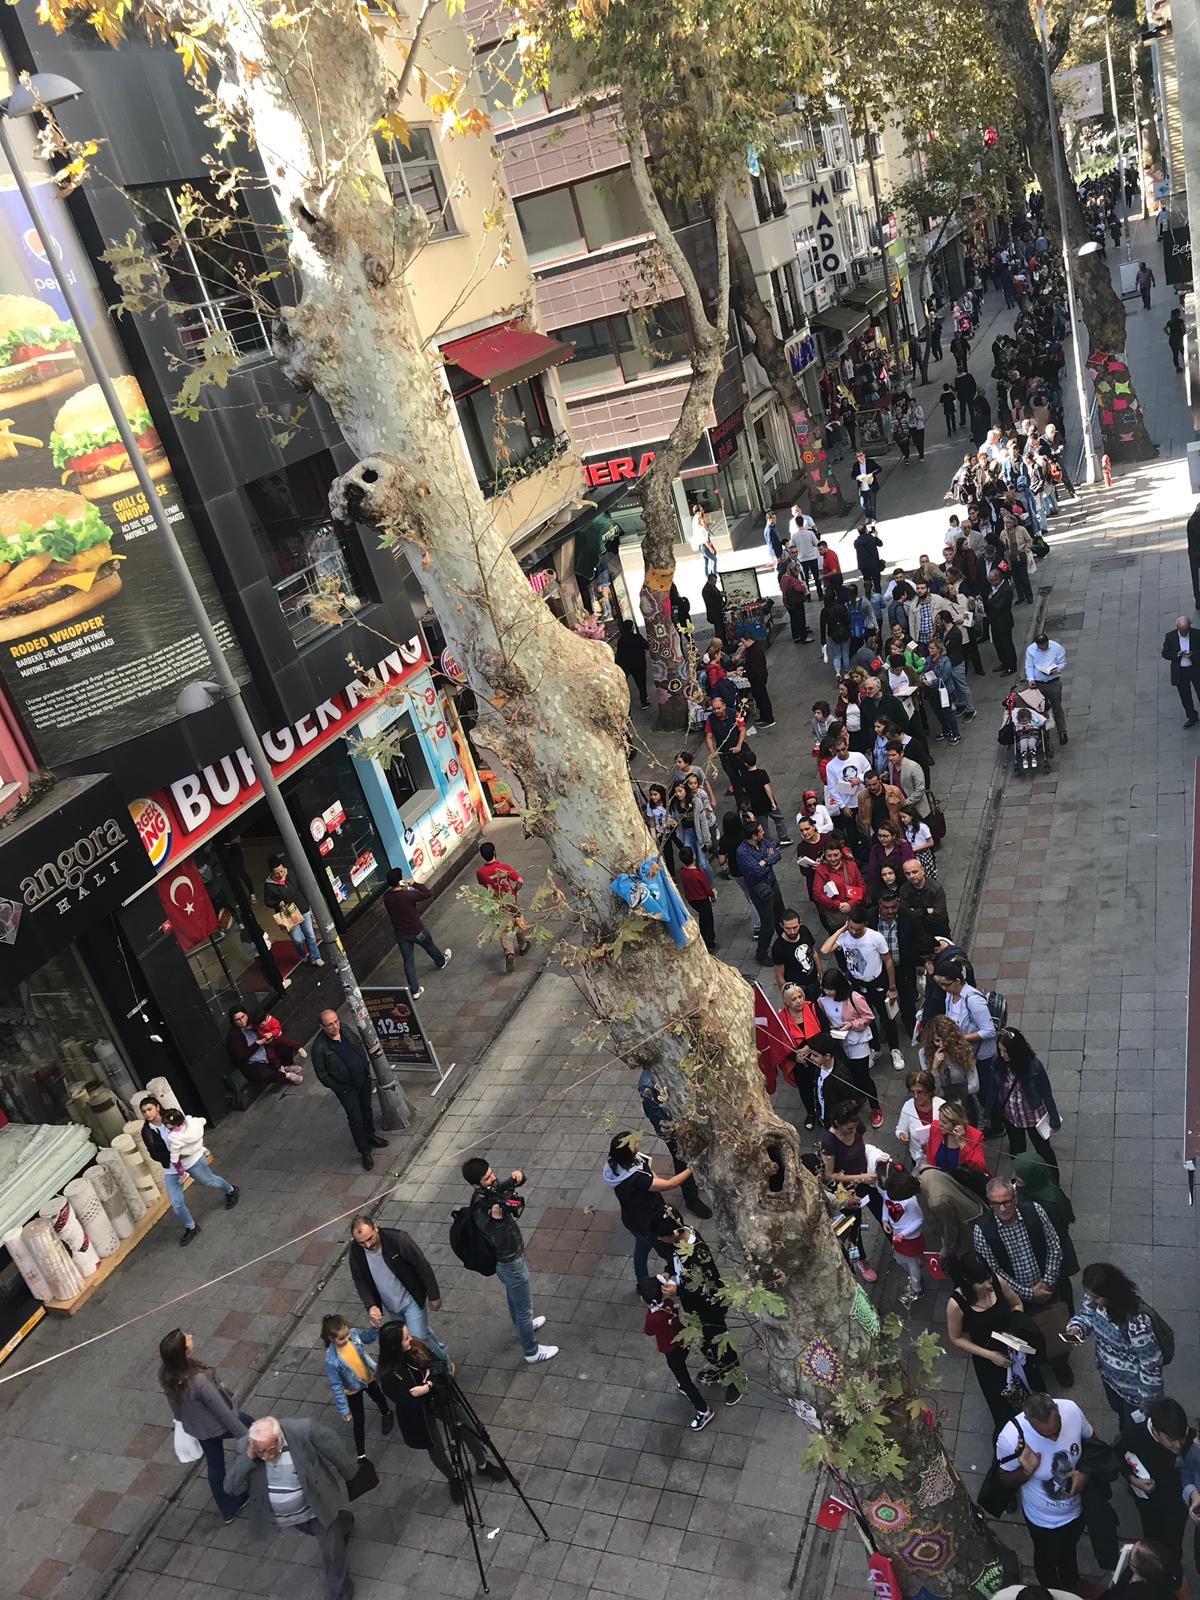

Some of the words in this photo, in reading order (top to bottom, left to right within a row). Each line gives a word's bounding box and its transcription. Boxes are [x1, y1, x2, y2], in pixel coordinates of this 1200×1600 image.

[811, 185, 840, 272] MADO
[10, 636, 49, 657] RODEO
[15, 653, 44, 669] BARBEKÜ
[57, 639, 85, 654] CHEDDAR
[71, 647, 91, 660] SOĞAN
[90, 637, 115, 654] HALKASI
[136, 803, 158, 832] RGER
[141, 812, 166, 851] ING
[20, 819, 125, 905] angora
[56, 861, 120, 914] HALI
